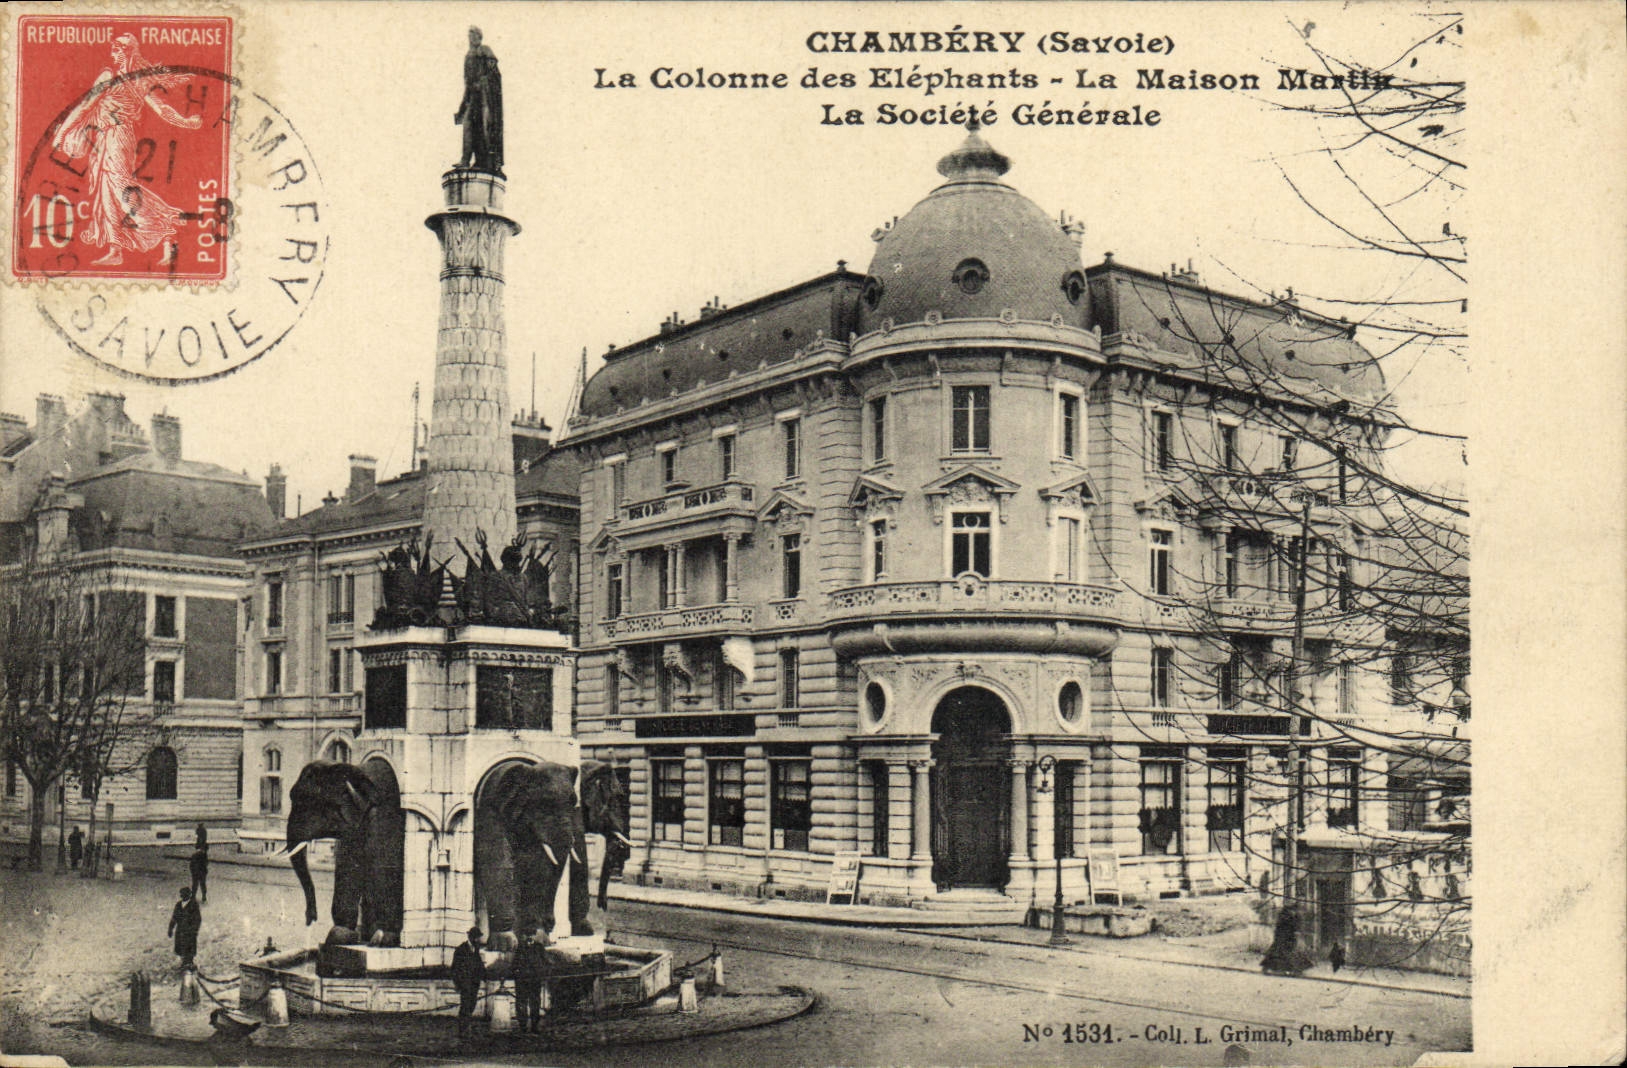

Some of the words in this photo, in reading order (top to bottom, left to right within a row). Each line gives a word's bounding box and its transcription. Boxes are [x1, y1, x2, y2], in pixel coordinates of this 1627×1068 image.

[141, 26, 222, 45] FRANÇAISE
[198, 179, 217, 262] POSTES
[71, 294, 263, 367] SAVOIE
